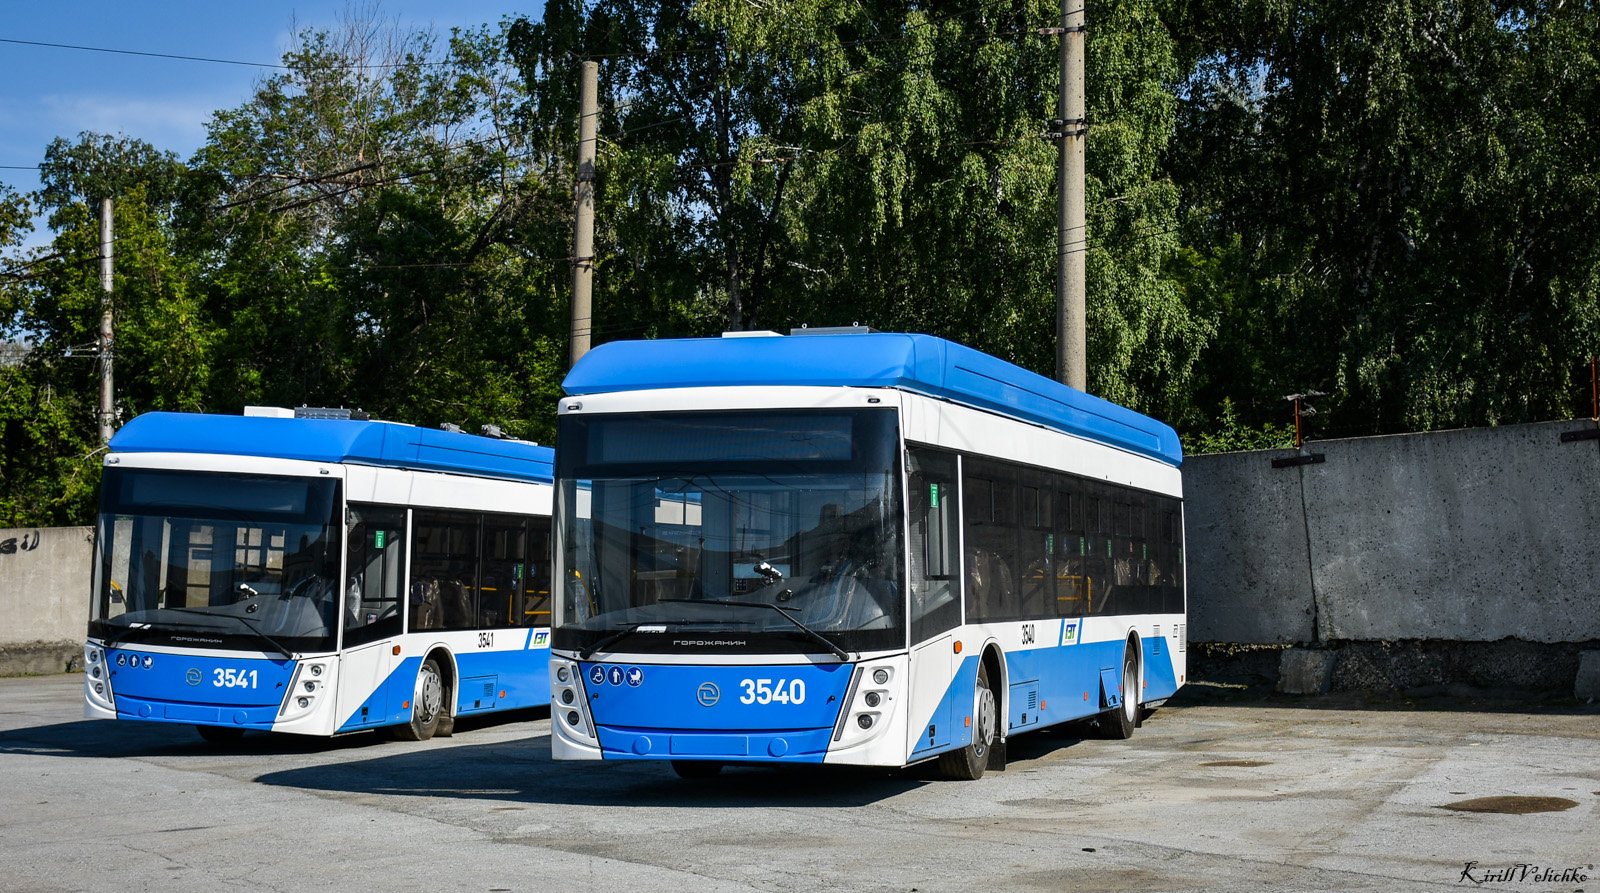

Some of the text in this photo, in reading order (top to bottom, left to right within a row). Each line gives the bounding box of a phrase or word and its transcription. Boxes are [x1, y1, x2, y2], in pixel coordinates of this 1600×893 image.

[170, 635, 222, 643] ГОРОЖАНИН
[477, 632, 494, 648] 3541
[1021, 623, 1035, 645] 3540
[213, 668, 257, 689] 3541
[739, 678, 806, 705] 3540
